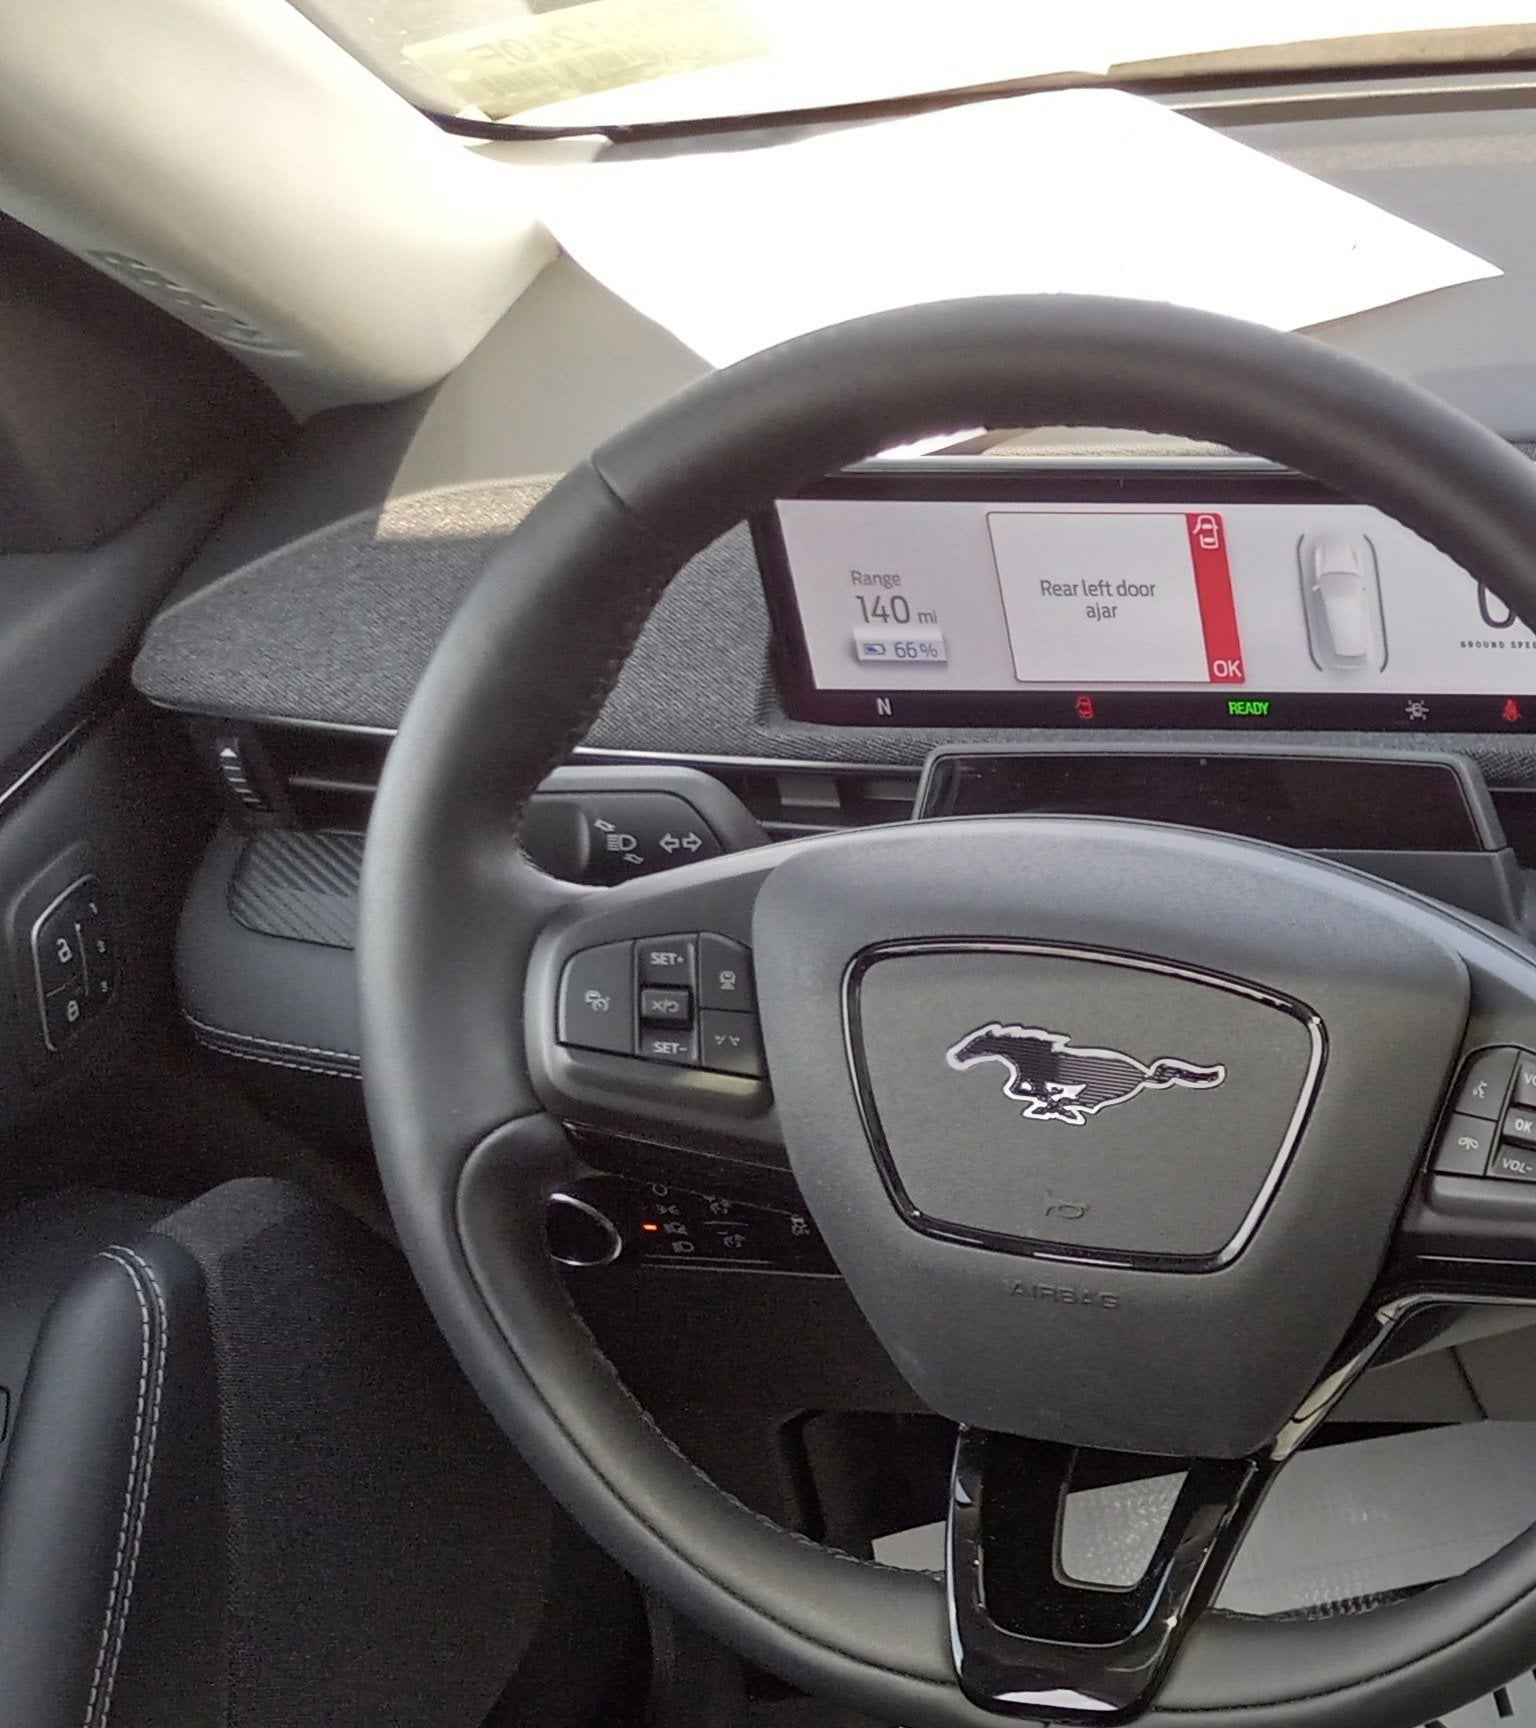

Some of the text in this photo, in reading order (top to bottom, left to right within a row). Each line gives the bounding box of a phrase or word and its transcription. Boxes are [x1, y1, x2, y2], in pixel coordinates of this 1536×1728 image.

[851, 570, 901, 590] Range
[1040, 578, 1156, 598] Rear left door
[856, 595, 937, 625] 140 mi
[1086, 602, 1117, 622] ajar
[893, 640, 937, 660] 66%
[1213, 659, 1241, 678] OK
[877, 699, 891, 717] N
[1228, 701, 1269, 717] READY
[1515, 1118, 1533, 1133] OK
[1010, 1280, 1118, 1308] AIRBAG
